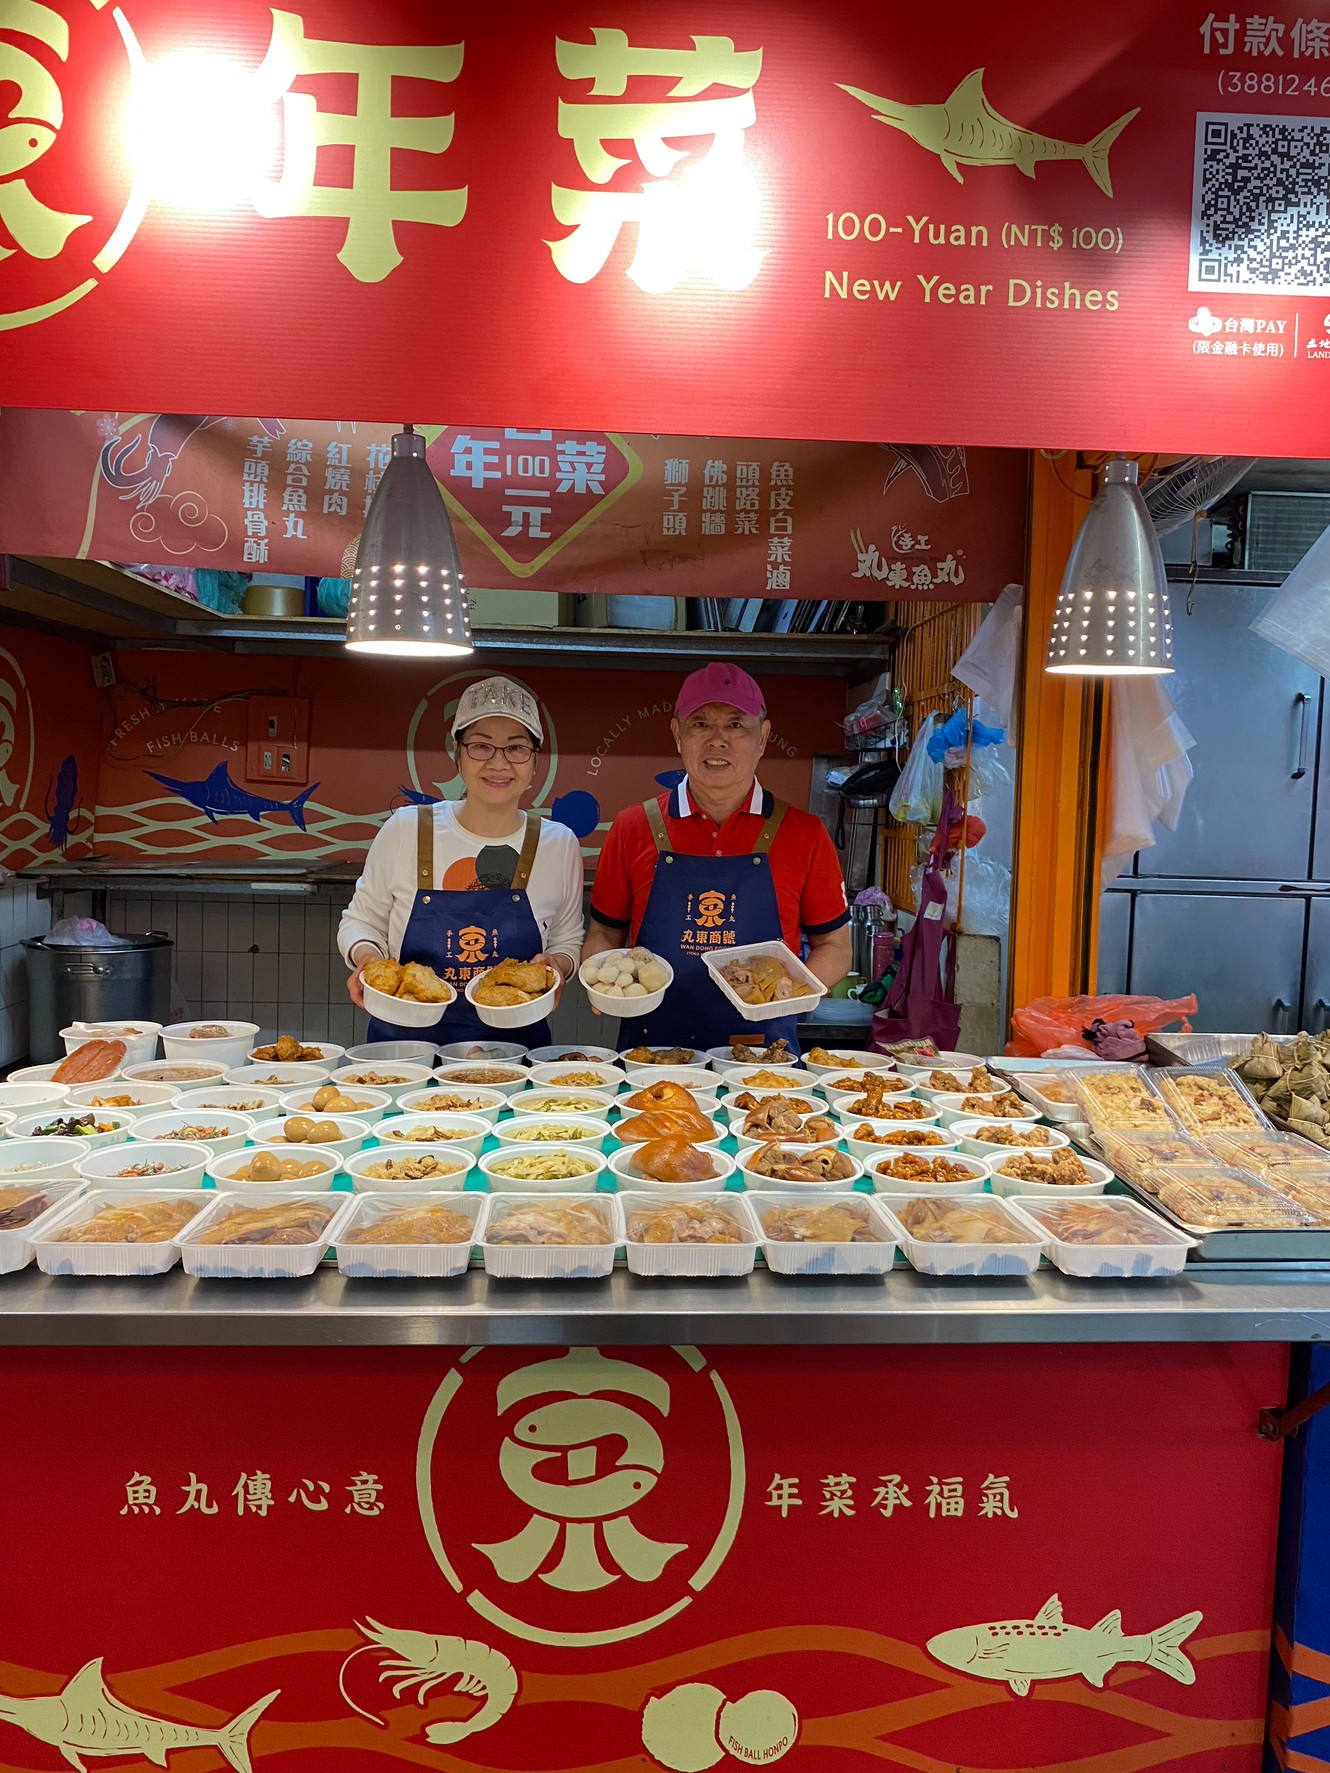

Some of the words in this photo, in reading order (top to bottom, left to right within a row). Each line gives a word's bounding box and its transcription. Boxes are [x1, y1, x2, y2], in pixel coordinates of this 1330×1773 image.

[1199, 13, 1330, 59] 付款條
[826, 212, 988, 247] 100-Yuan
[1001, 222, 1063, 251] (NT$
[1072, 227, 1123, 254] 100)
[824, 271, 902, 301] New
[917, 275, 993, 305] Year
[1008, 279, 1119, 311] Dishes
[1192, 340, 1284, 358] (限金融卡使用)
[281, 438, 313, 539] 綜合魚丸
[322, 441, 352, 516] 紅燒肉
[506, 454, 550, 477] 100
[242, 435, 273, 564] 芋頭排骨酥
[662, 458, 690, 535] 獅子頭
[734, 461, 761, 535] 頭路菜
[765, 461, 795, 590] 魚皮白菜滷
[146, 731, 183, 753] FISH
[190, 731, 240, 752] BALLS
[587, 716, 632, 777] LOCALLY
[681, 929, 736, 944] 丸東商號
[119, 1470, 385, 1516] 魚丸傳心意
[764, 1473, 1019, 1518] 年菜承福氣
[728, 1736, 743, 1754] FISH
[745, 1748, 761, 1760] BALL
[763, 1737, 788, 1758] HONPO
